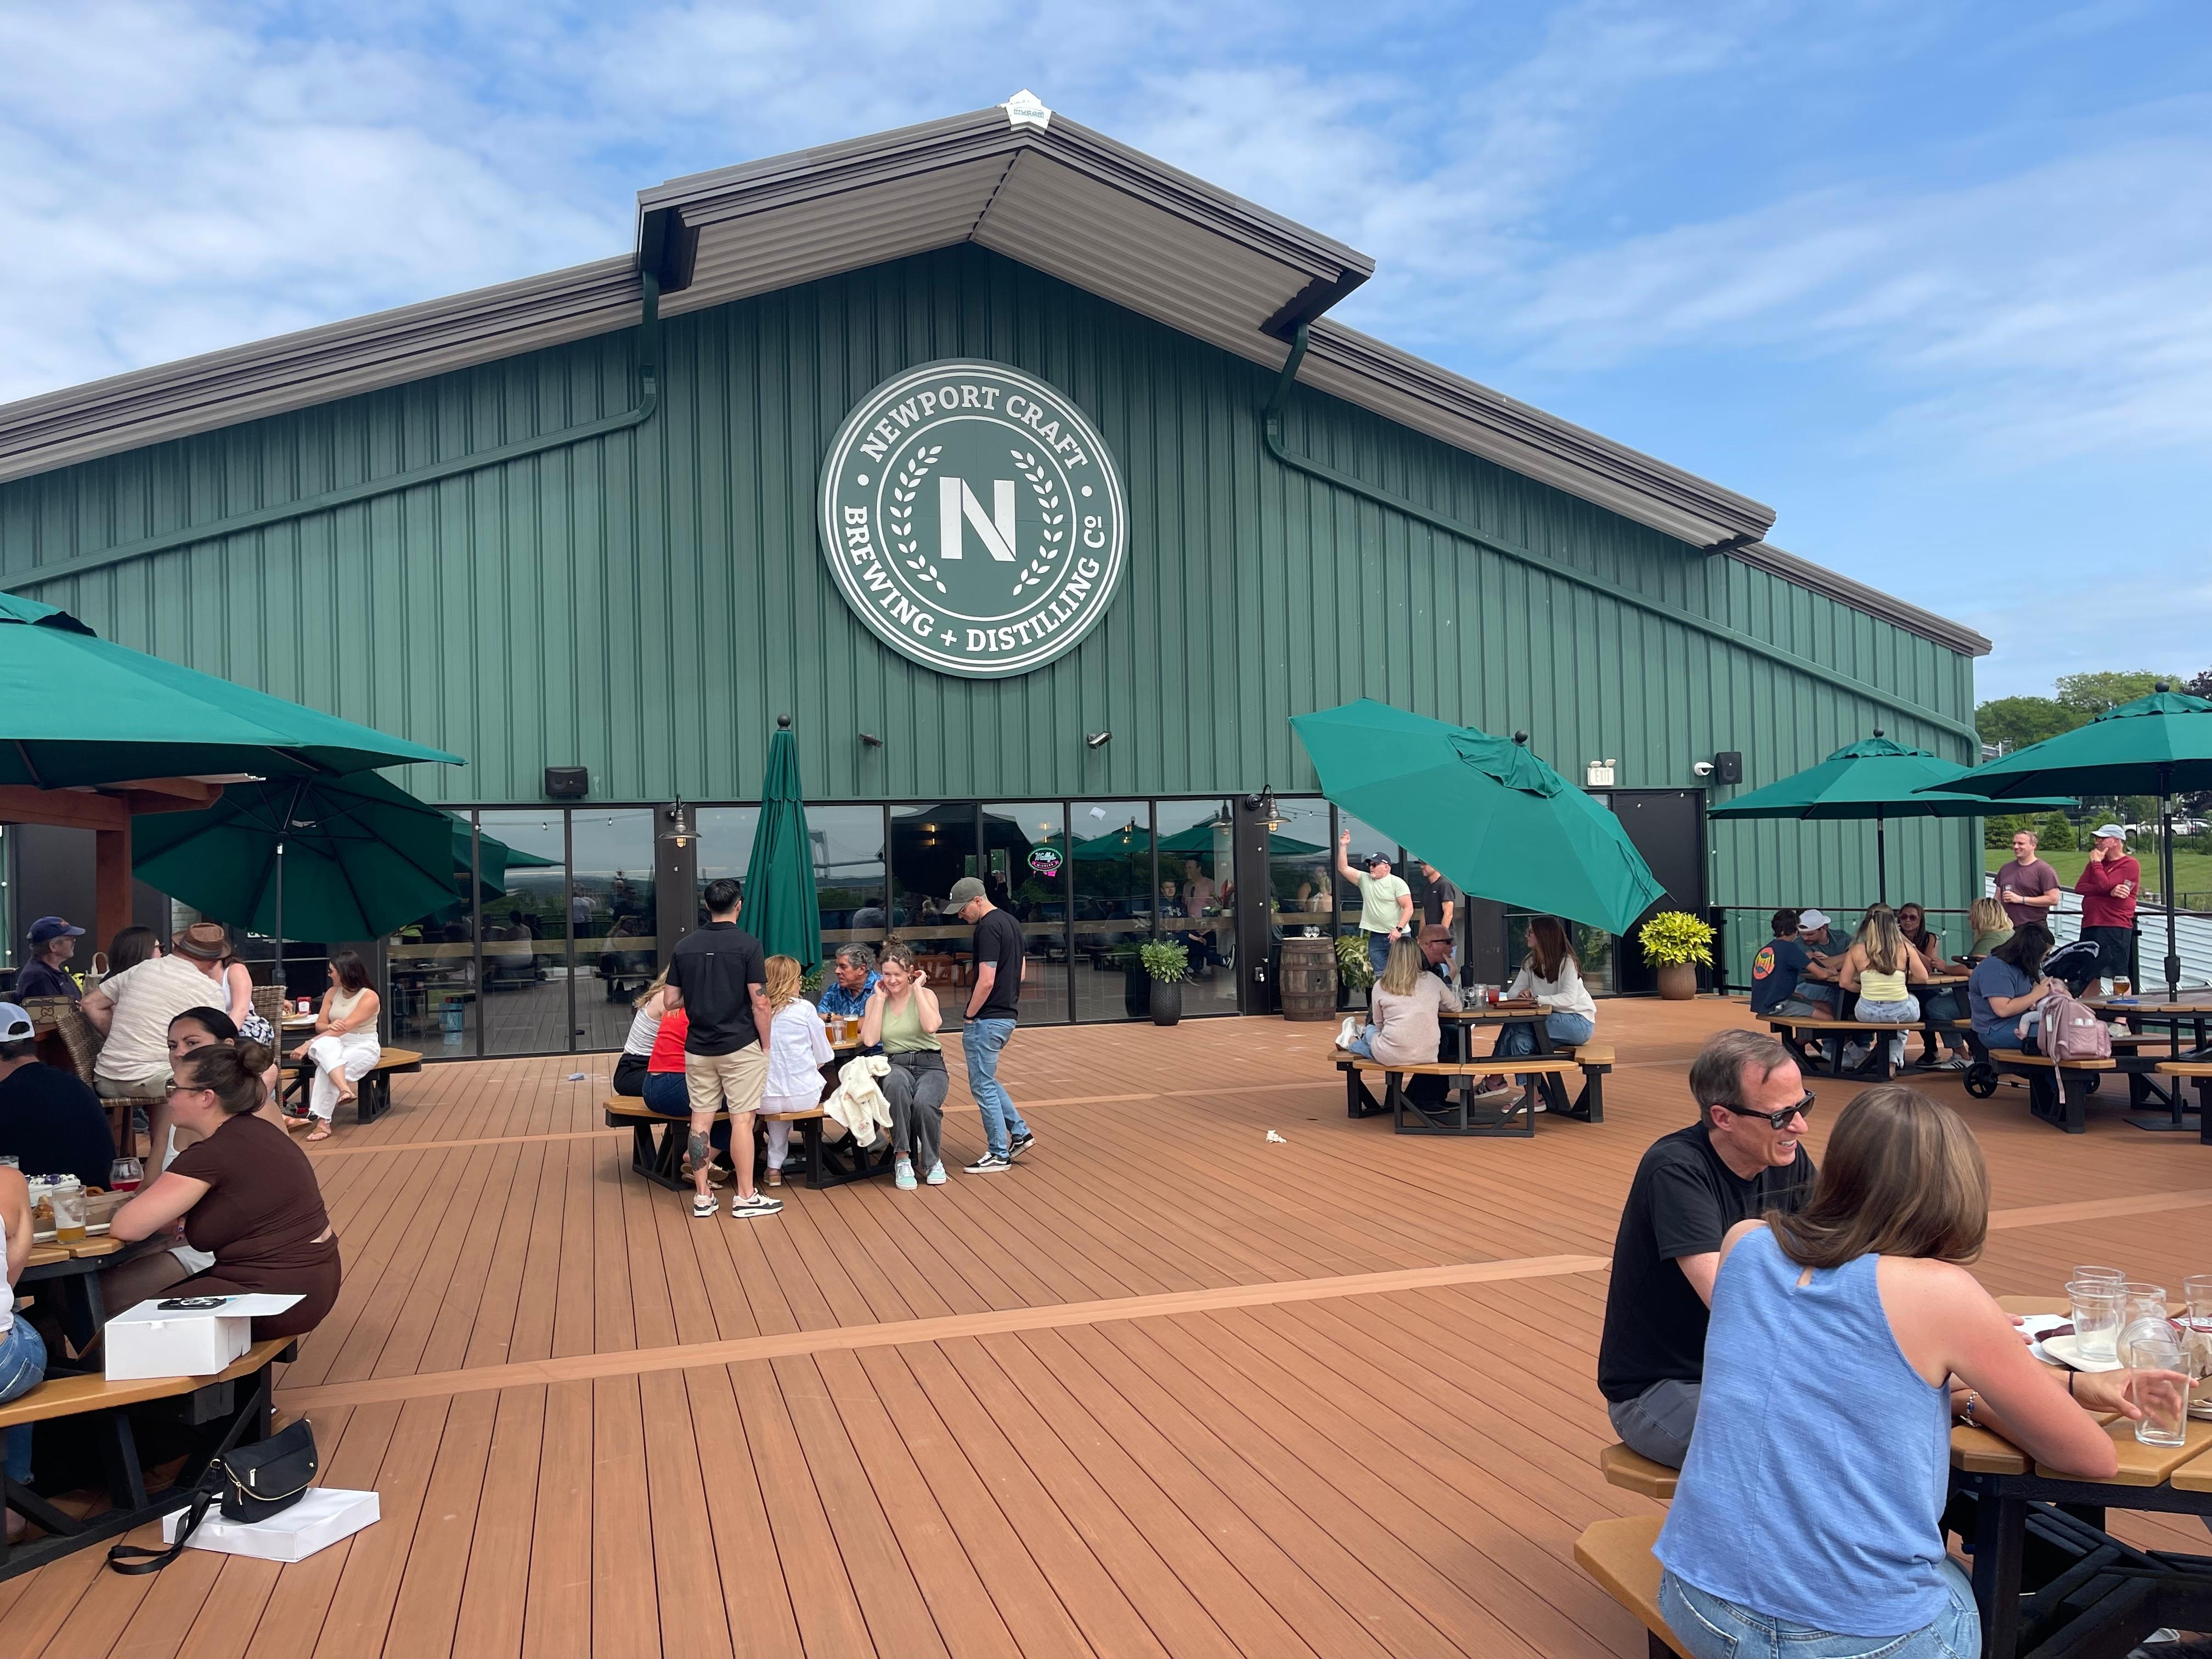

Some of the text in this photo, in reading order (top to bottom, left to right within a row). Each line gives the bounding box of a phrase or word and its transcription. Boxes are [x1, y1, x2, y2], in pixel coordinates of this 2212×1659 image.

[860, 385, 1088, 470] NEWPORT CRAFT
[939, 476, 1016, 562] N
[844, 506, 935, 637] BREWING
[966, 557, 1099, 652] DISTILLING
[1595, 769, 1610, 783] EXIT
